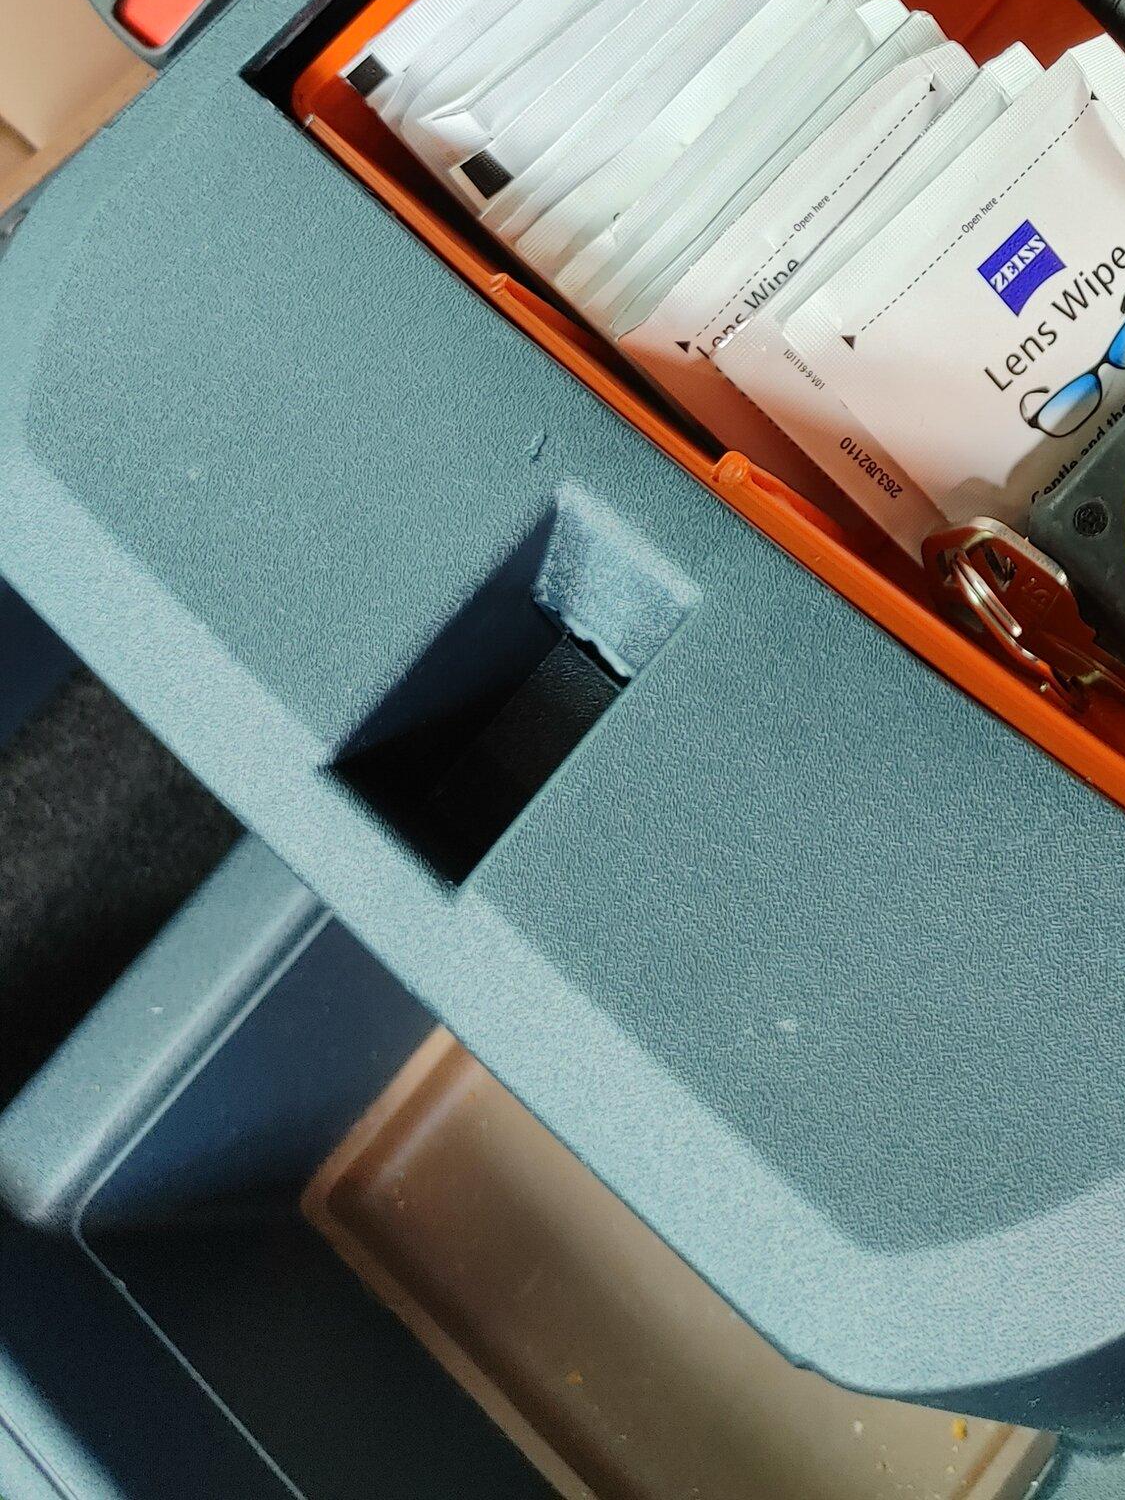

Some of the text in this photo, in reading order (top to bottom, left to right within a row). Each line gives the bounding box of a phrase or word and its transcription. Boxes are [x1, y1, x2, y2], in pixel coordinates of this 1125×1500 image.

[793, 194, 831, 232] Open here
[961, 197, 999, 234] Open here
[990, 234, 1048, 291] ZEISS
[984, 320, 1058, 392] Lens
[840, 437, 903, 498] 263J82110
